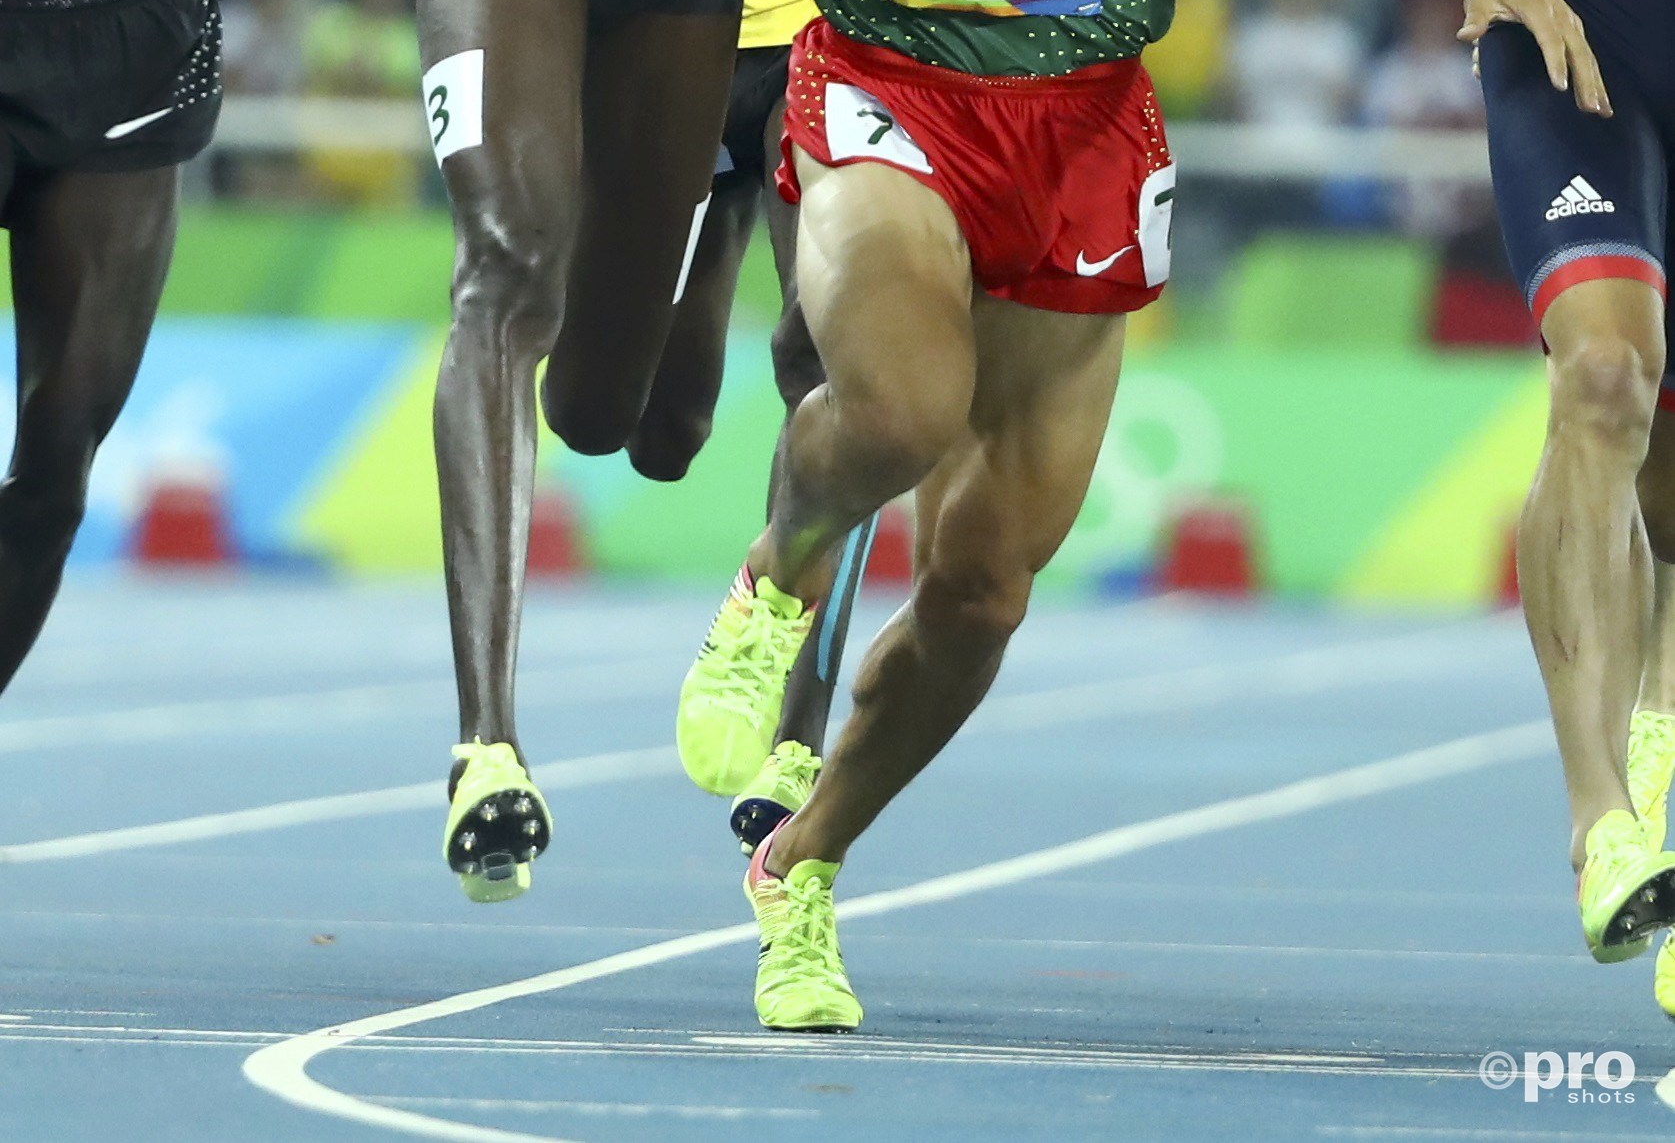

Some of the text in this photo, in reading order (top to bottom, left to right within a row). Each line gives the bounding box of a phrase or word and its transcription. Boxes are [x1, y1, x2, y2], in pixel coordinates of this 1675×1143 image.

[428, 85, 450, 147] 3
[857, 107, 893, 145] 7
[1545, 199, 1615, 221] adidas
